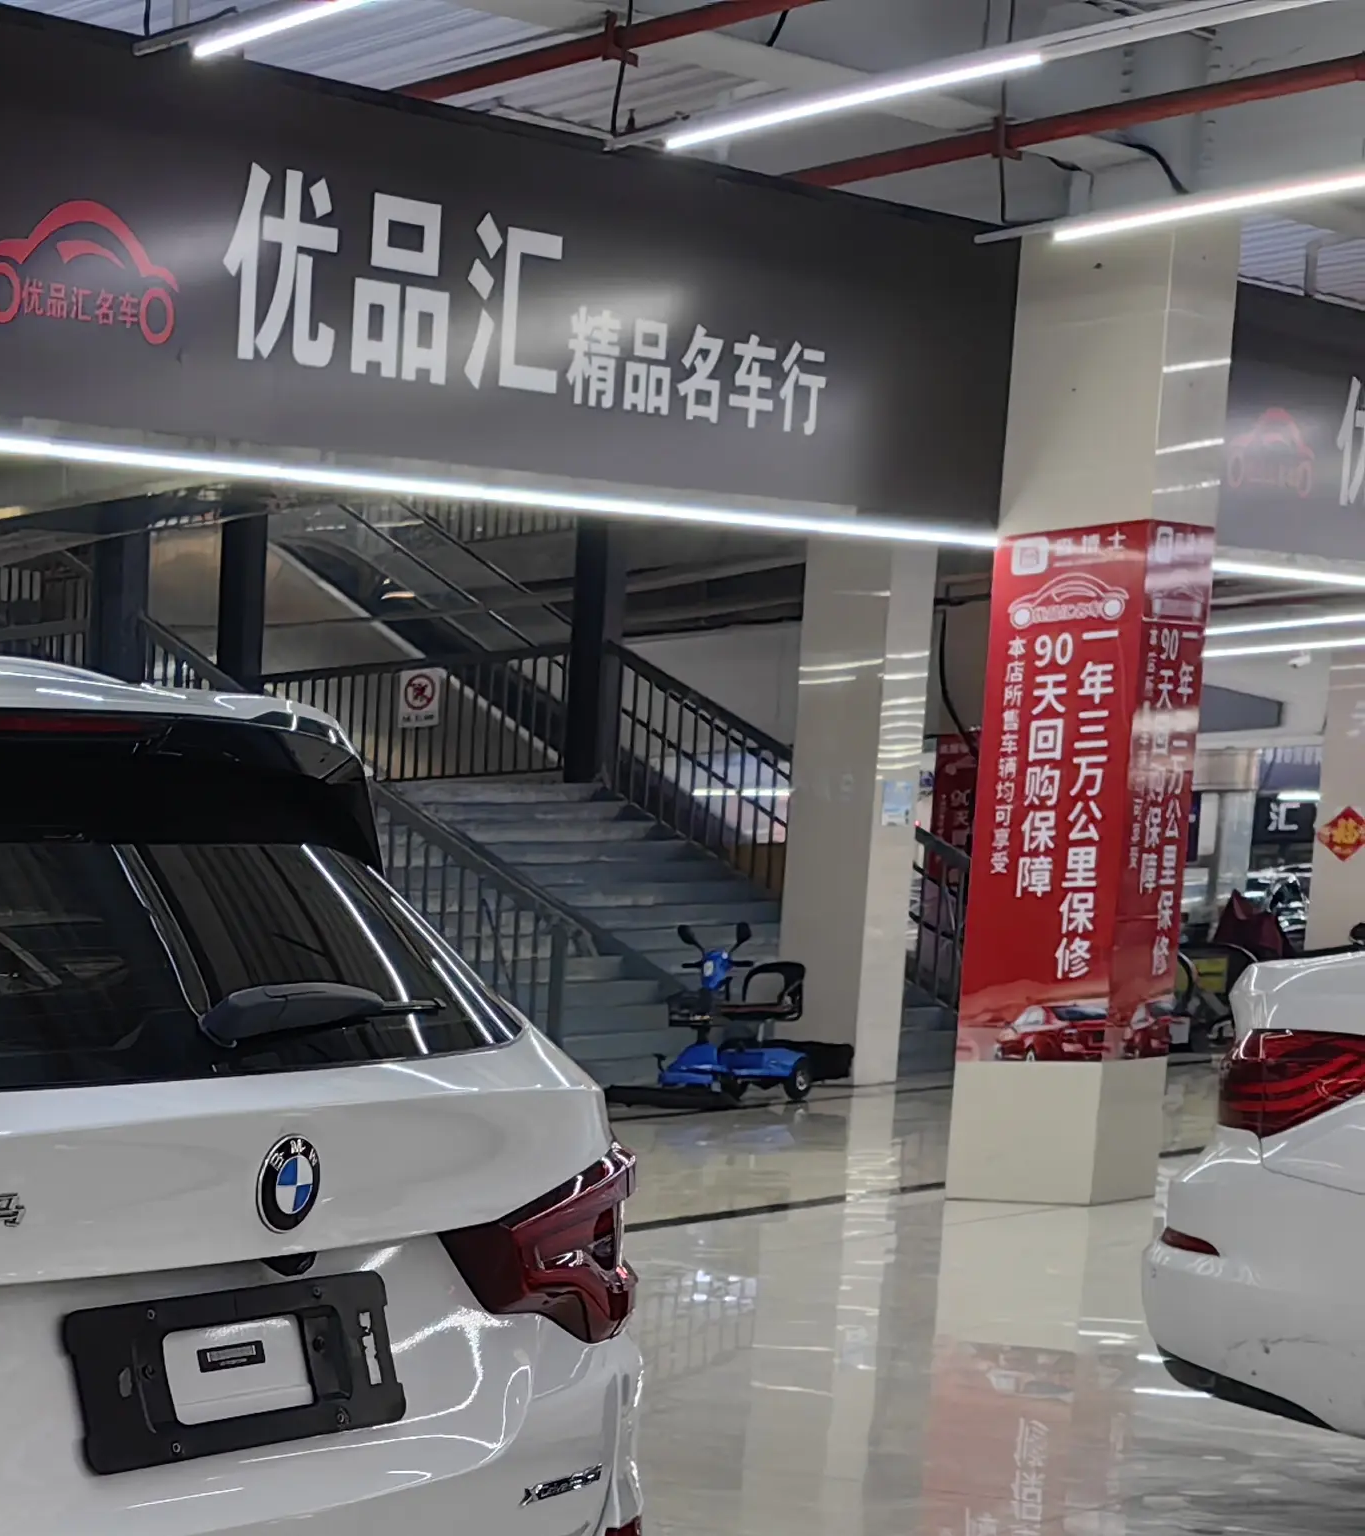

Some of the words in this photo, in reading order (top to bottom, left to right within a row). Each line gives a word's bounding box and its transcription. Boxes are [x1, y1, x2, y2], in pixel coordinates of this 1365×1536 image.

[21, 275, 139, 329] 优品汇名车
[222, 161, 564, 396] 优品汇
[566, 304, 828, 436] 精品名车行
[989, 635, 1027, 875] 本店所售车辆均可享受
[1015, 632, 1074, 898] 90天回购保障
[1055, 628, 1119, 979] 一年三万公里保修
[1267, 802, 1299, 832] 汇
[269, 1138, 319, 1172] BMW
